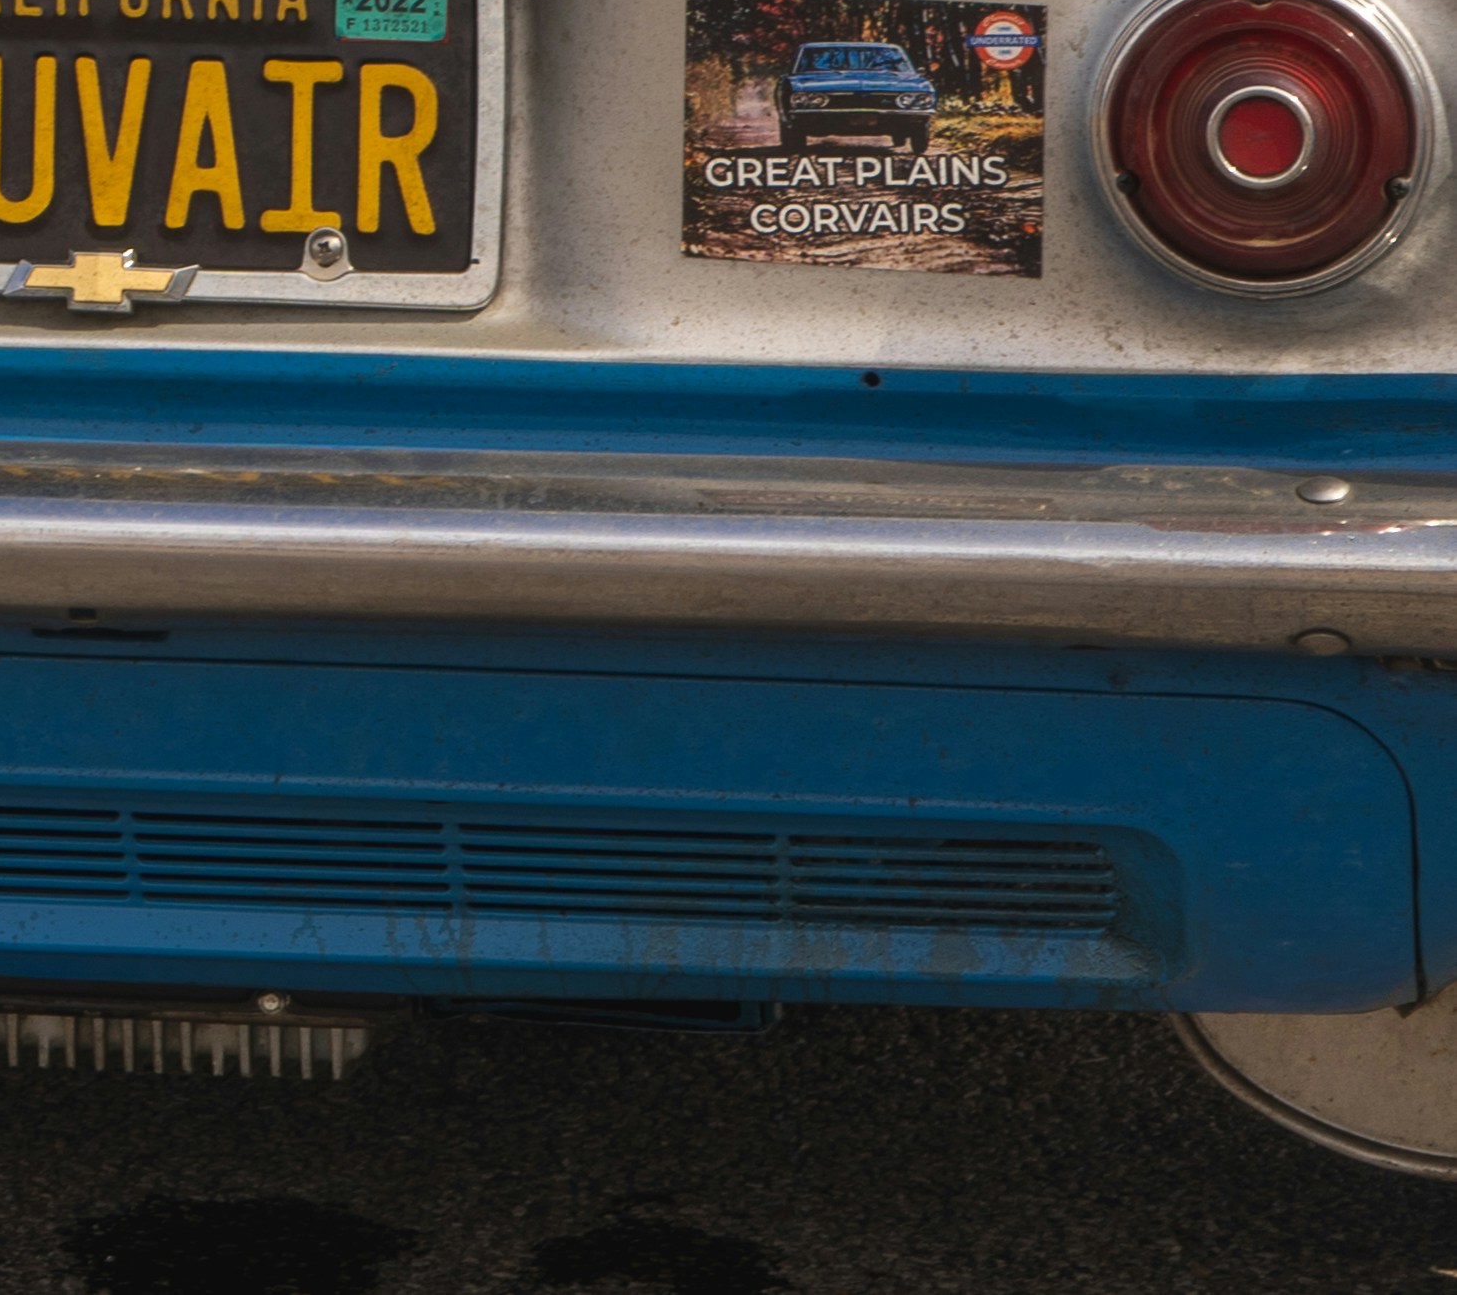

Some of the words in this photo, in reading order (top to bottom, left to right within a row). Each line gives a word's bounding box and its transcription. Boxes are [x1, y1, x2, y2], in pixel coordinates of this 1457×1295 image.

[704, 156, 844, 187] GREAT
[856, 155, 1008, 187] PLAINS
[749, 202, 967, 235] CORVAIRS
